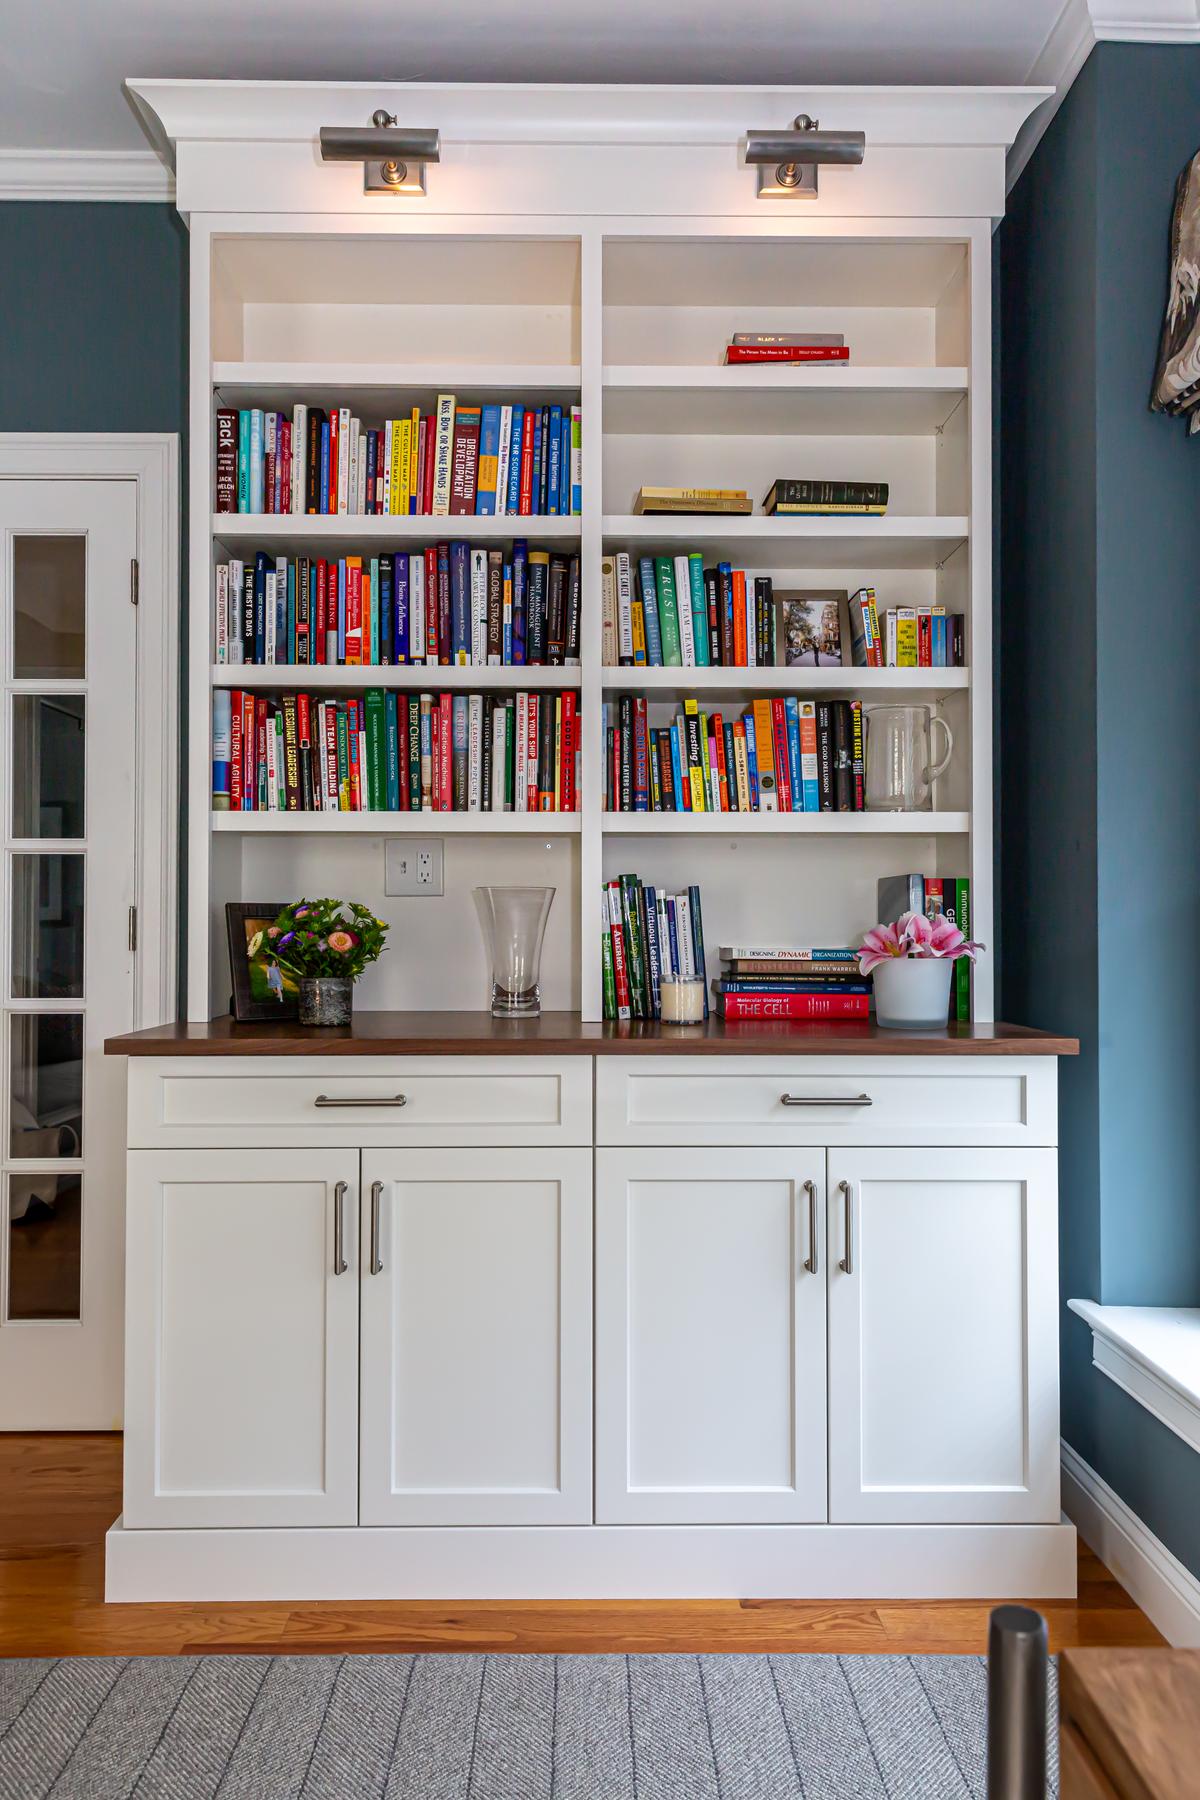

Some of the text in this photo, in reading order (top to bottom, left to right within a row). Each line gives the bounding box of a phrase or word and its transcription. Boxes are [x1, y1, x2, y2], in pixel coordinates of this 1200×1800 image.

[217, 415, 235, 448] jack
[439, 435, 448, 445] OR
[501, 445, 509, 455] Big
[268, 453, 276, 485] RESPECT
[438, 446, 449, 465] SHAKE
[453, 438, 466, 497] DEVELOPMENT
[463, 438, 476, 499] ORGANIZATION
[510, 427, 521, 502] THE HR SCORECARD
[240, 472, 248, 499] WOMEN
[437, 467, 448, 489] HANDS
[398, 581, 407, 601] Points
[472, 572, 480, 608] FLAWLESS
[620, 557, 630, 598] CURING CANCER
[661, 564, 675, 621] TRUST
[723, 580, 730, 590] My
[245, 589, 253, 608] FIRST
[245, 609, 253, 619] 90
[352, 569, 360, 628] Emotional Intelligence
[490, 570, 500, 644] GLOBAL STRATEGY
[528, 586, 536, 629] HANDBOOK
[534, 567, 543, 648] TALENT MANAGEMENT
[644, 588, 654, 615] CALM
[245, 620, 253, 637] DAYS
[398, 606, 406, 636] Influence
[570, 610, 578, 648] DYNAMICS
[349, 706, 358, 765] Seeing Systems
[410, 703, 420, 762] DEEP CHANGE
[496, 716, 505, 740] blink
[528, 703, 537, 758] IT'S YOUR SHIP
[689, 721, 700, 761] Investing
[853, 709, 862, 759] BUSTING VEGAS
[231, 715, 240, 799] CULTURAL AGILITY
[285, 708, 298, 789] RESONANT LEADERSHIP
[327, 726, 337, 795] TEAM BUILDING
[441, 719, 449, 790] Prediction Machines
[662, 761, 673, 793] SARCASM
[822, 761, 830, 793] DELUSION
[614, 930, 623, 971] AMERICA
[647, 906, 659, 979] Virtuous Leaders
[737, 1003, 793, 1015] THE CELL
